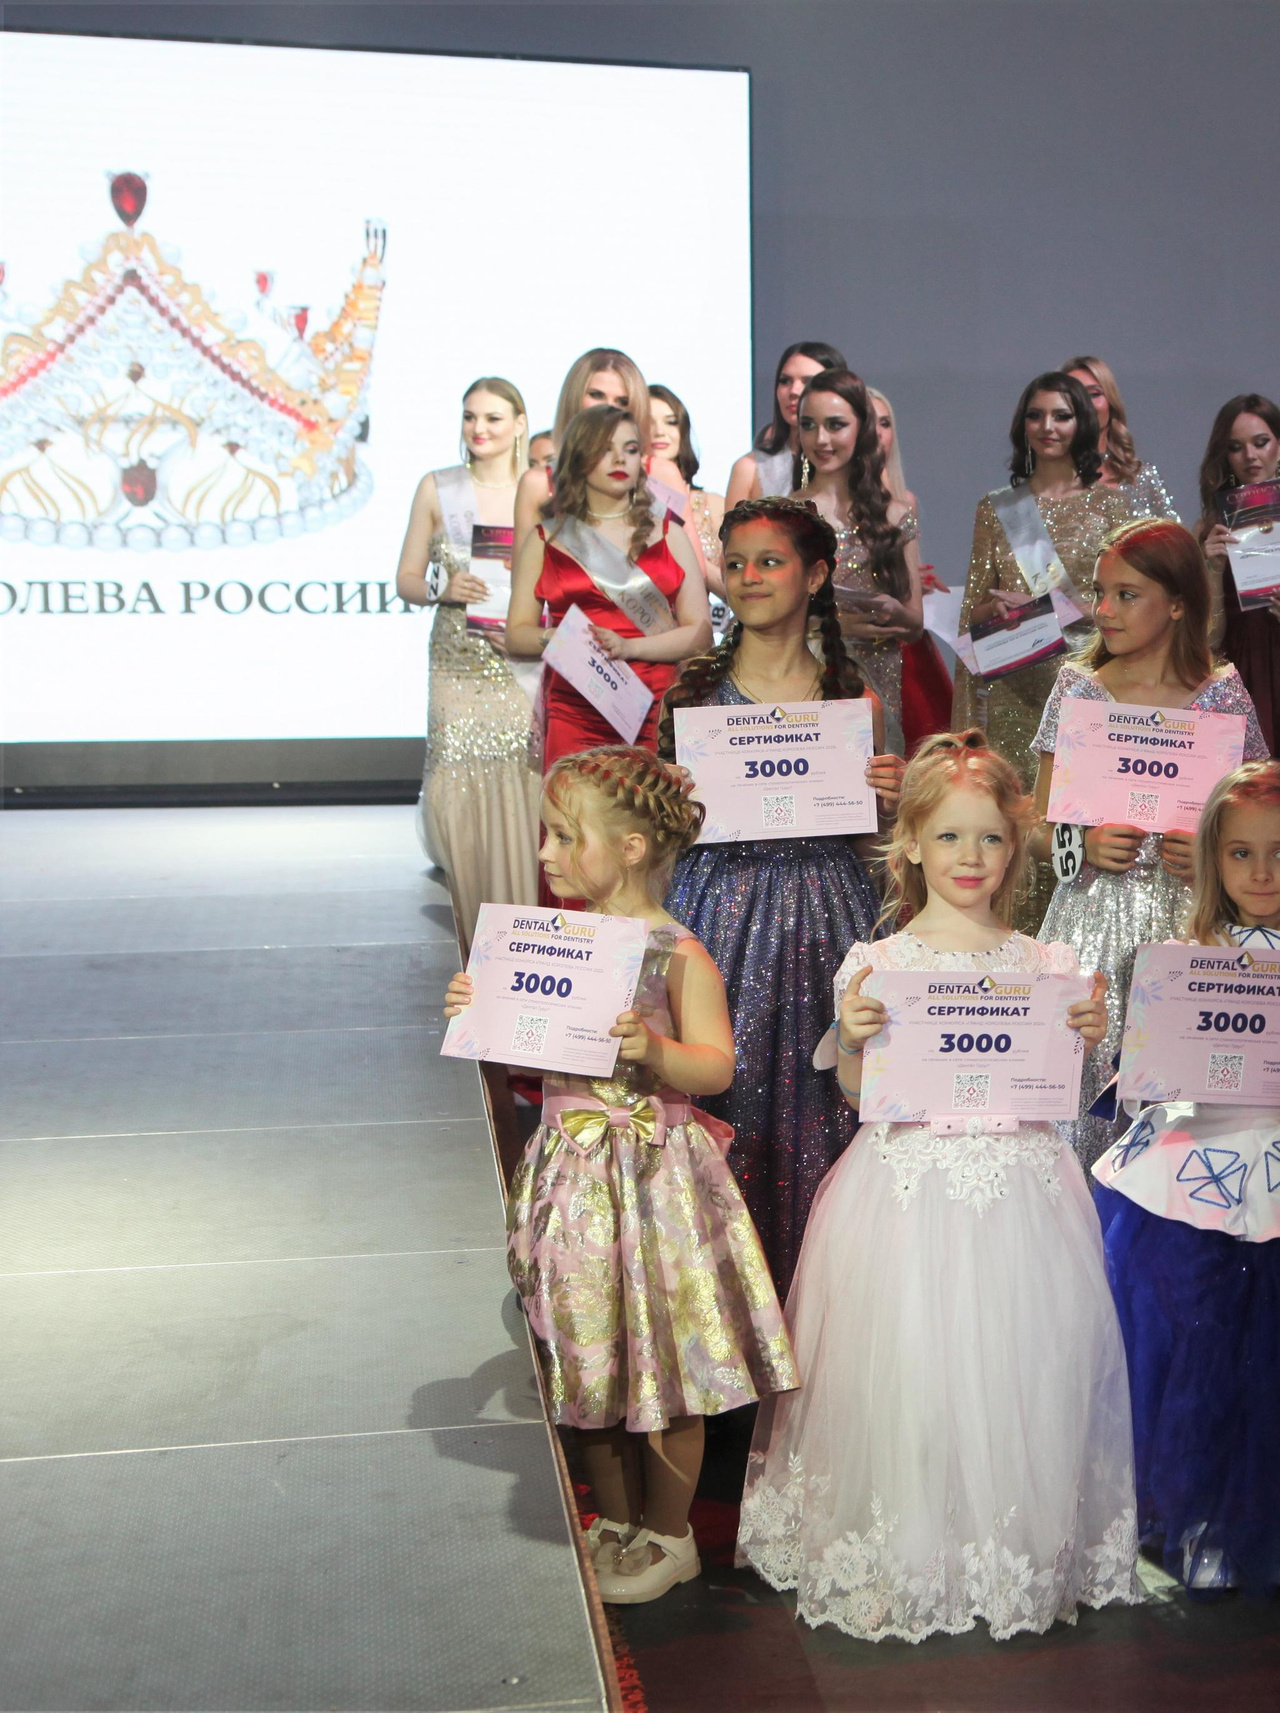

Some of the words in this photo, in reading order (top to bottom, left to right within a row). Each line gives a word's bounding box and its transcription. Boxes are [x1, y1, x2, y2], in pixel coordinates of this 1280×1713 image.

[179, 581, 437, 615] РОССИИ
[588, 657, 618, 690] 3000
[726, 715, 772, 726] DENTAL
[786, 713, 819, 723] GURU
[1108, 714, 1151, 726] DENTAL
[728, 731, 821, 746] СЕРТИФИКАТ
[1108, 732, 1195, 749] СЕРТИФИКАТ
[742, 757, 809, 778] 3000
[1117, 756, 1178, 779] 3000
[1056, 823, 1076, 877] 55
[512, 919, 551, 932] DENTAL
[564, 925, 596, 936] GURU
[508, 941, 592, 961] СЕРТИФИКАТ
[1189, 959, 1237, 970] DENTAL
[510, 970, 572, 999] 3000
[928, 984, 978, 994] DENTAL
[994, 986, 1030, 994] GURU
[927, 1006, 1030, 1016] СЕРТИФИКАТ
[1196, 1010, 1265, 1034] 3000
[938, 1033, 1011, 1052] 3000
